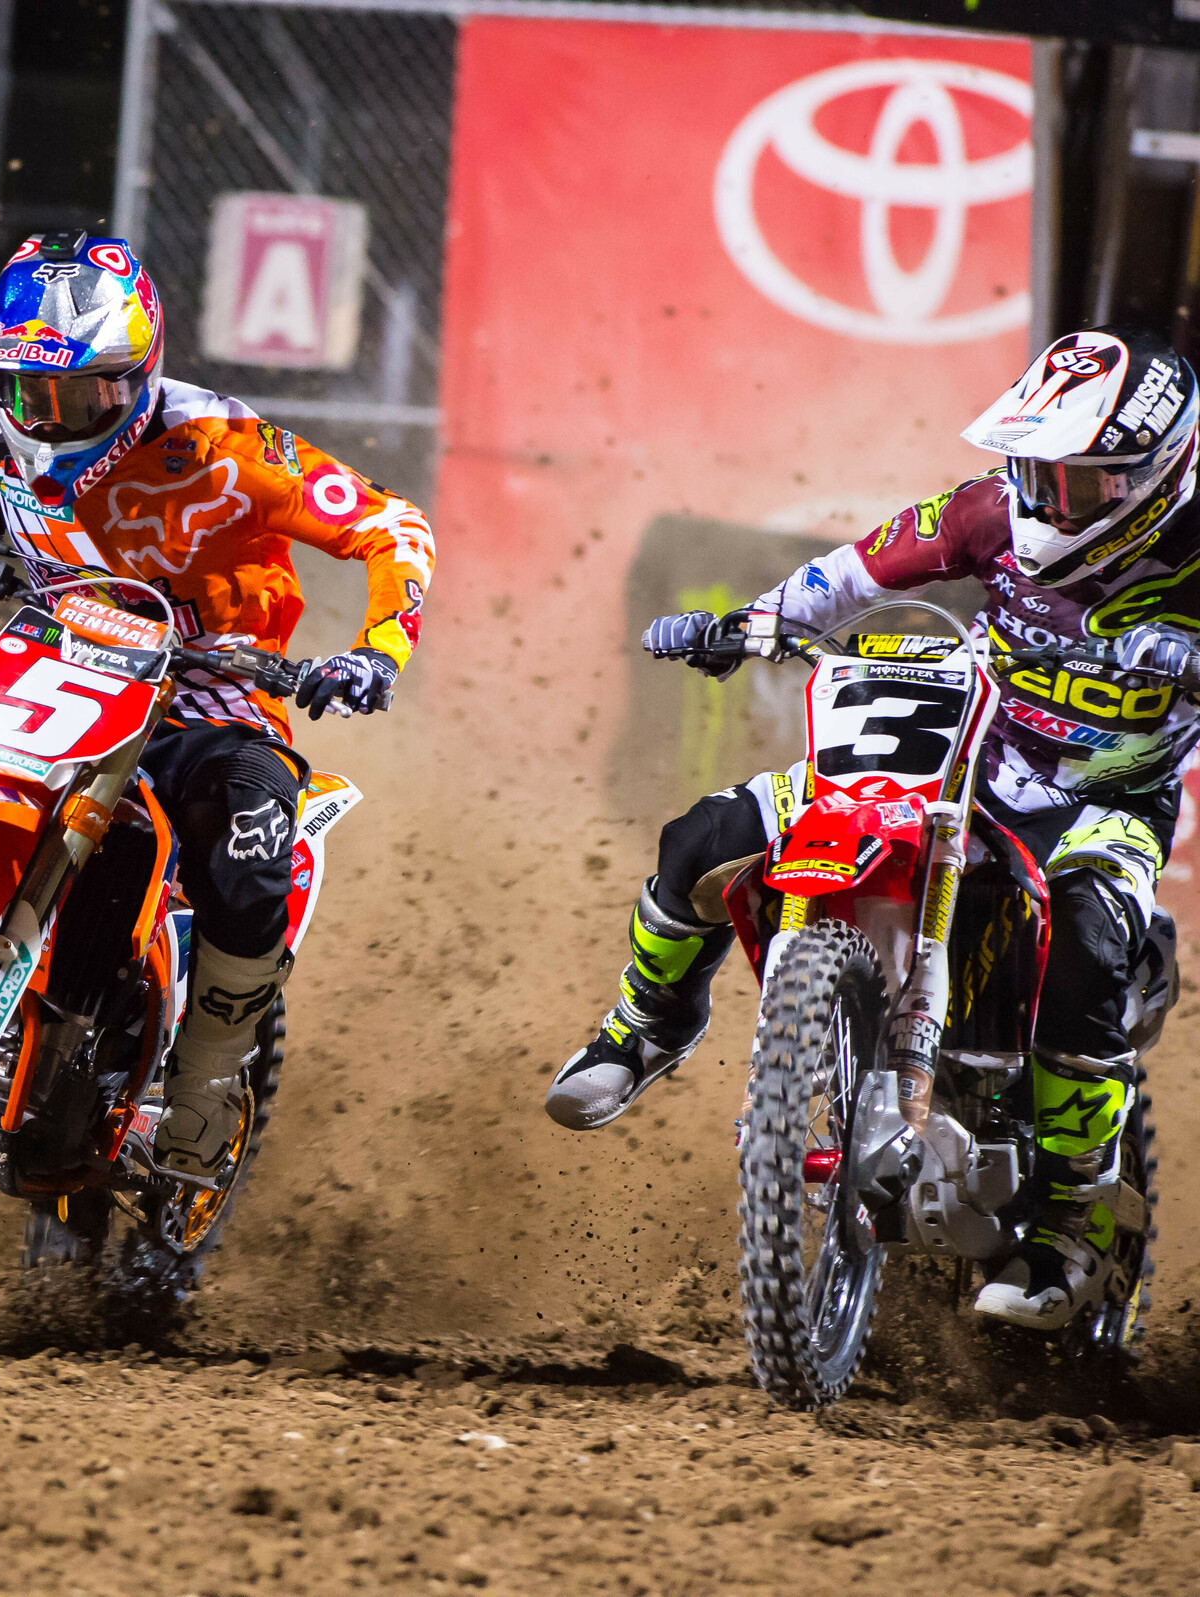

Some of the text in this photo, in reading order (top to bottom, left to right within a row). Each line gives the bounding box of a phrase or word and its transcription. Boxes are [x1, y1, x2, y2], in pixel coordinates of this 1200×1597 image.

[241, 243, 315, 346] A
[26, 348, 74, 368] Bull
[1116, 357, 1175, 432] MUSCLE
[1144, 382, 1186, 436] MILK
[998, 415, 1048, 425] AMSOIL
[979, 439, 1019, 453] HONDA
[1085, 498, 1168, 566] GEICO
[59, 607, 158, 651] RENTHAL
[68, 596, 159, 633] RENTHAL
[869, 665, 935, 680] MONSTER
[1063, 660, 1103, 674] ARC
[817, 680, 969, 777] 3
[1002, 697, 1127, 752] AMSOIL
[806, 761, 815, 799] GEICO
[945, 763, 966, 801] GEICO
[303, 801, 341, 837] DUNLOP
[879, 802, 918, 824] AMSOIL
[770, 859, 858, 876] GEICO
[855, 838, 883, 866] DUNLOP
[772, 870, 846, 883] HONDA
